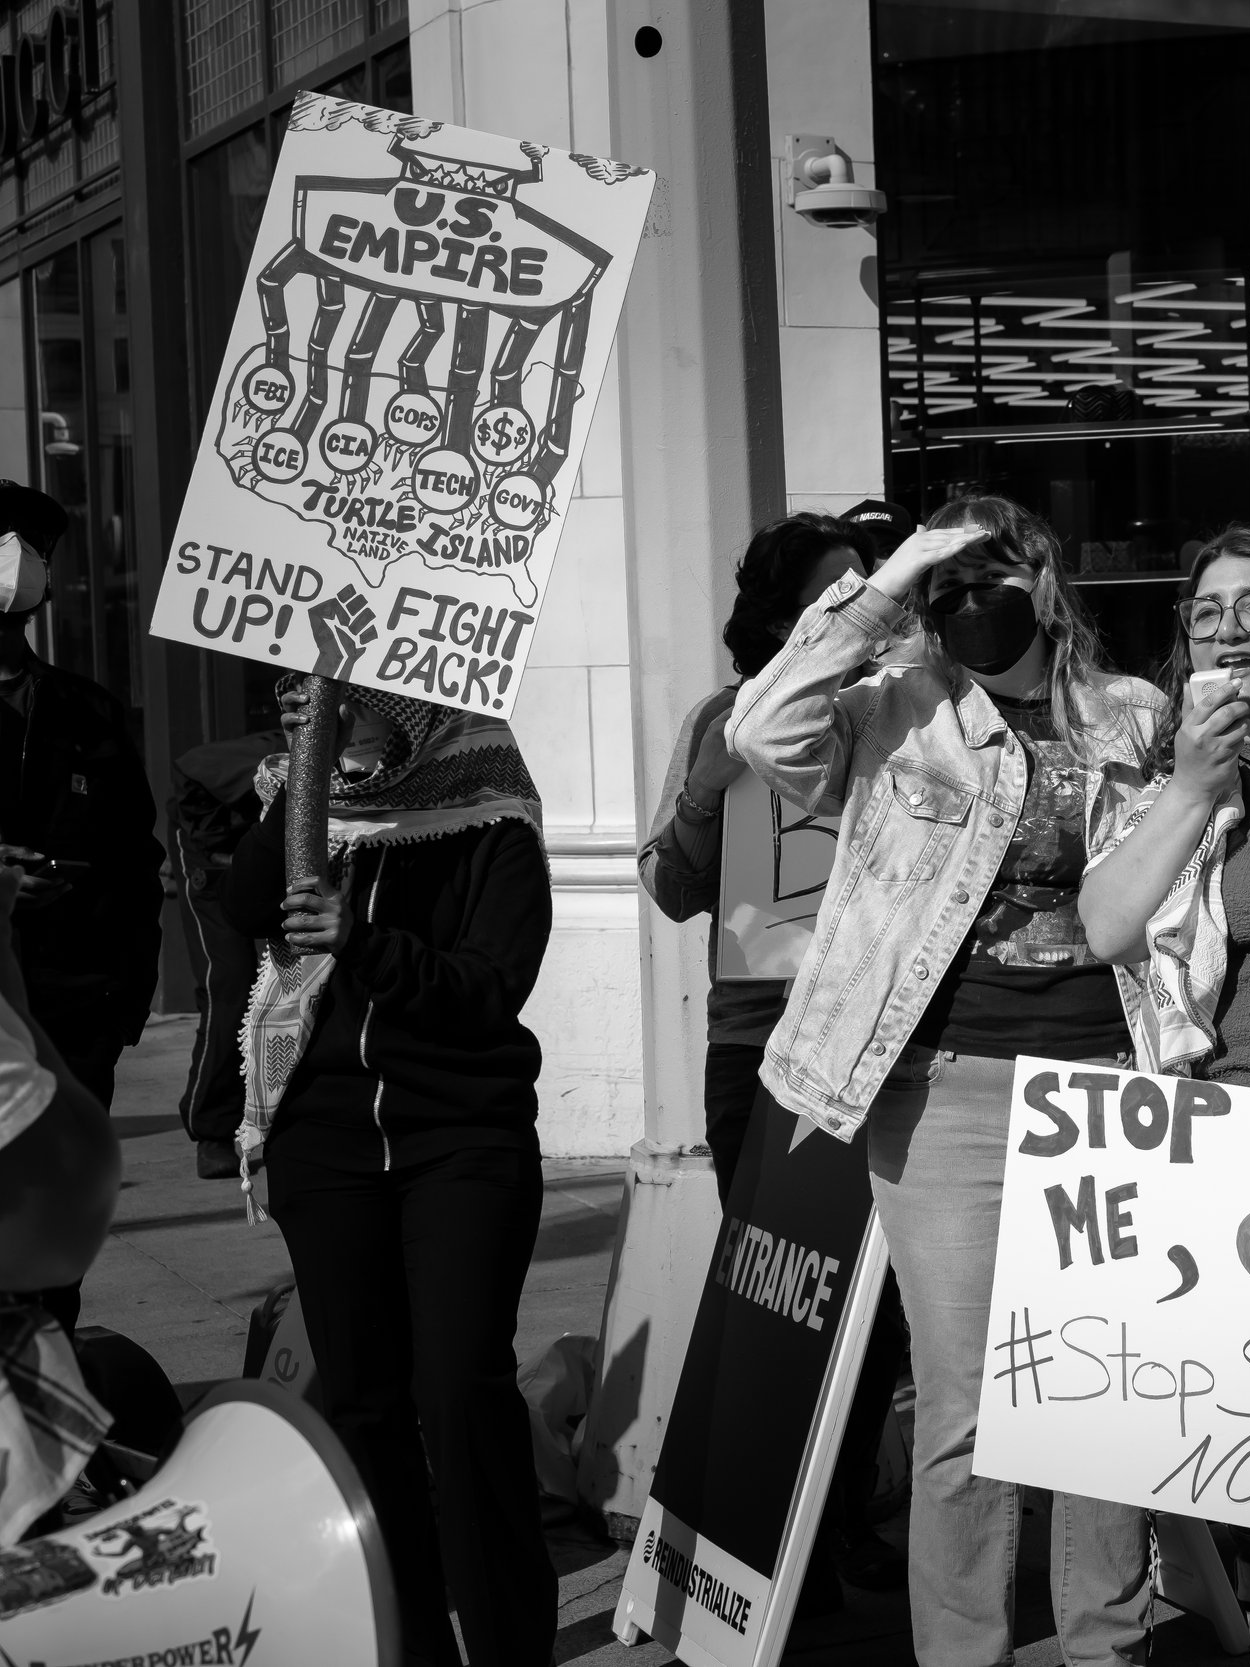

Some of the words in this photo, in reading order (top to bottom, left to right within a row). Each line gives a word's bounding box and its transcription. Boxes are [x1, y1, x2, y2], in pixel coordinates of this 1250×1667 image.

[394, 187, 503, 243] U.S.
[319, 214, 548, 296] EMPIRE
[253, 380, 288, 403] FBI
[391, 405, 438, 431] COPS
[478, 411, 529, 456] $$$
[259, 442, 300, 470] ICE
[327, 433, 370, 457] CIA
[417, 468, 475, 497] TECH
[496, 489, 543, 515] GOVT
[301, 479, 417, 533] TURTLE
[416, 522, 529, 568] ISLAND
[343, 526, 409, 554] NATIVE
[860, 512, 893, 522] NASCAR
[176, 541, 323, 602] STAND
[347, 541, 390, 561] LAND
[193, 587, 293, 656] UP!
[388, 587, 535, 659] FIGHT
[376, 637, 514, 710] BACK!
[1018, 1071, 1231, 1163] STOP
[716, 1217, 839, 1331] ENTRANCE
[652, 1536, 752, 1635] REINDUSTRIALIZE
